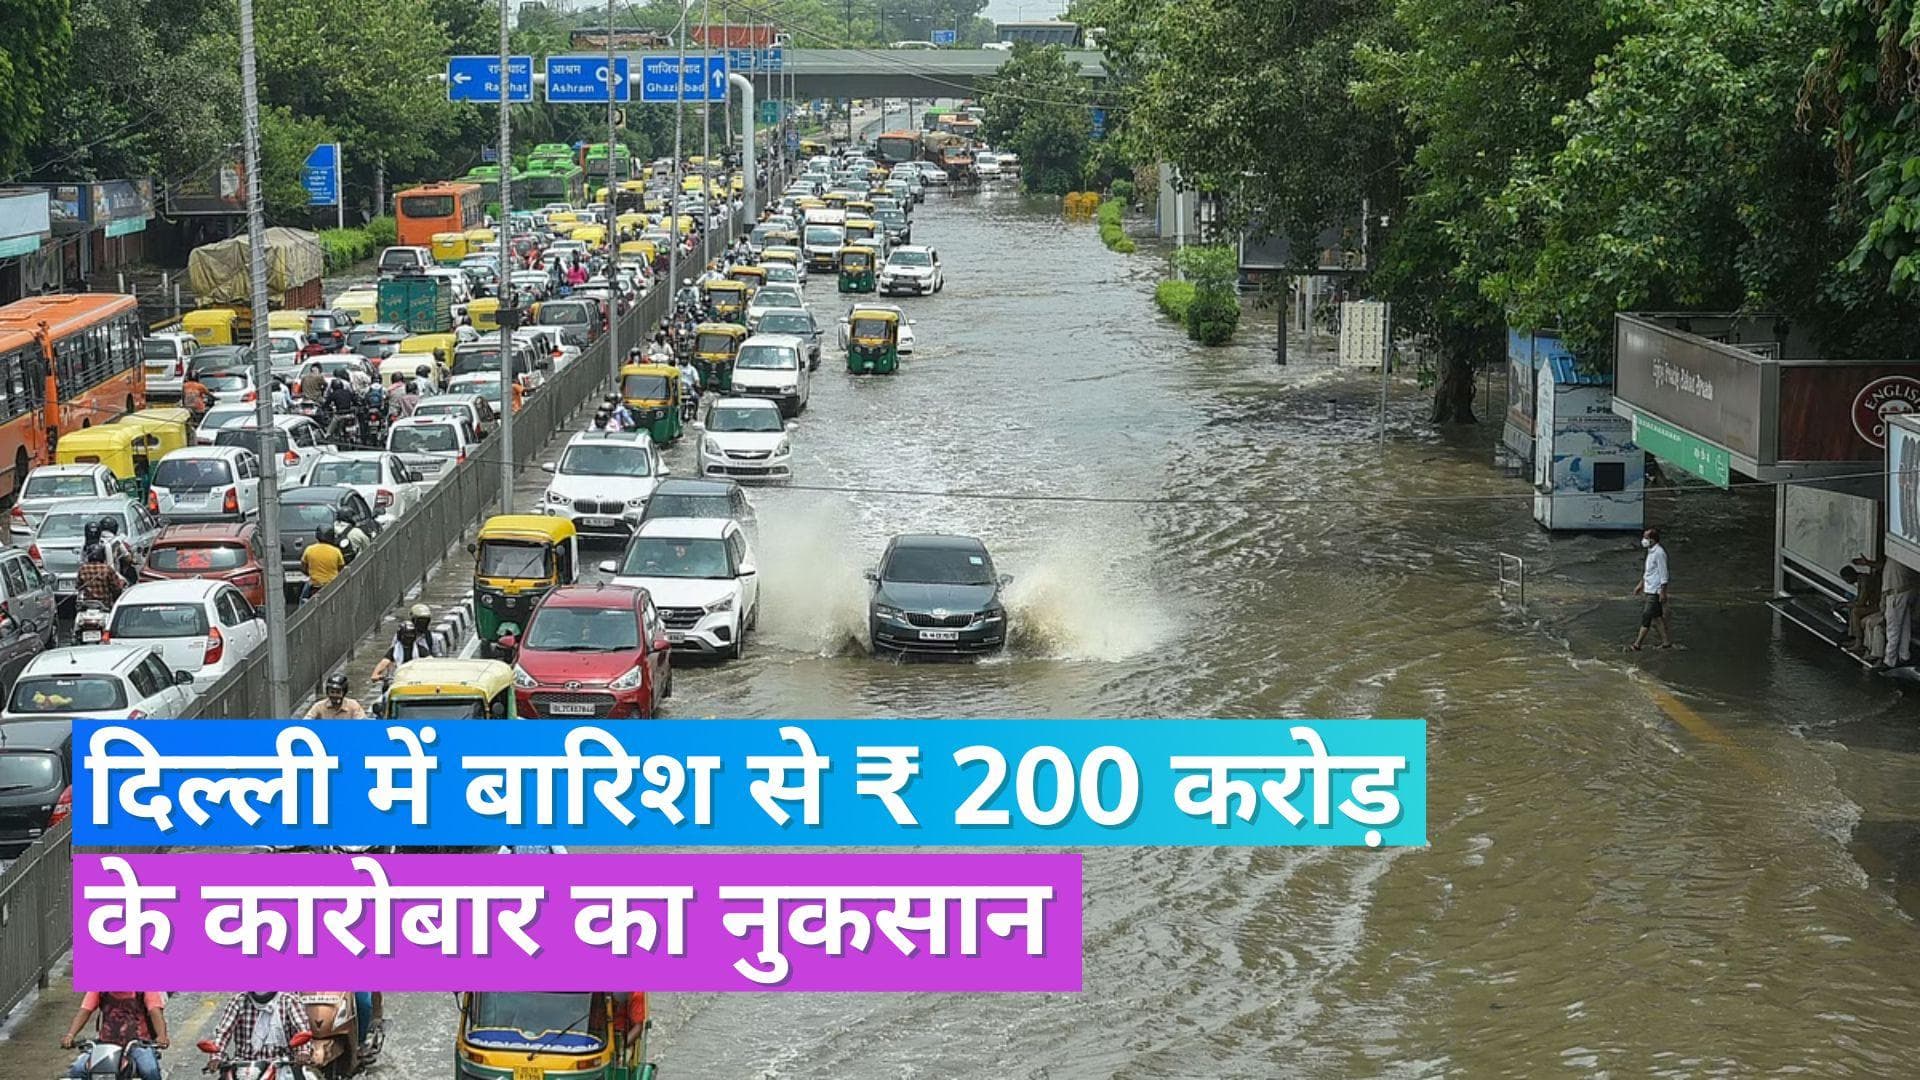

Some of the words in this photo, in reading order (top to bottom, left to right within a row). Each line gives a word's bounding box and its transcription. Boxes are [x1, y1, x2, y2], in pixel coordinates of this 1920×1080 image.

[488, 64, 528, 74] राघाट
[551, 64, 581, 74] आश्रम
[647, 60, 700, 74] गाजियबाद
[484, 82, 528, 93] Rahat
[551, 83, 595, 93] Ashram
[646, 83, 706, 93] Ghazibad
